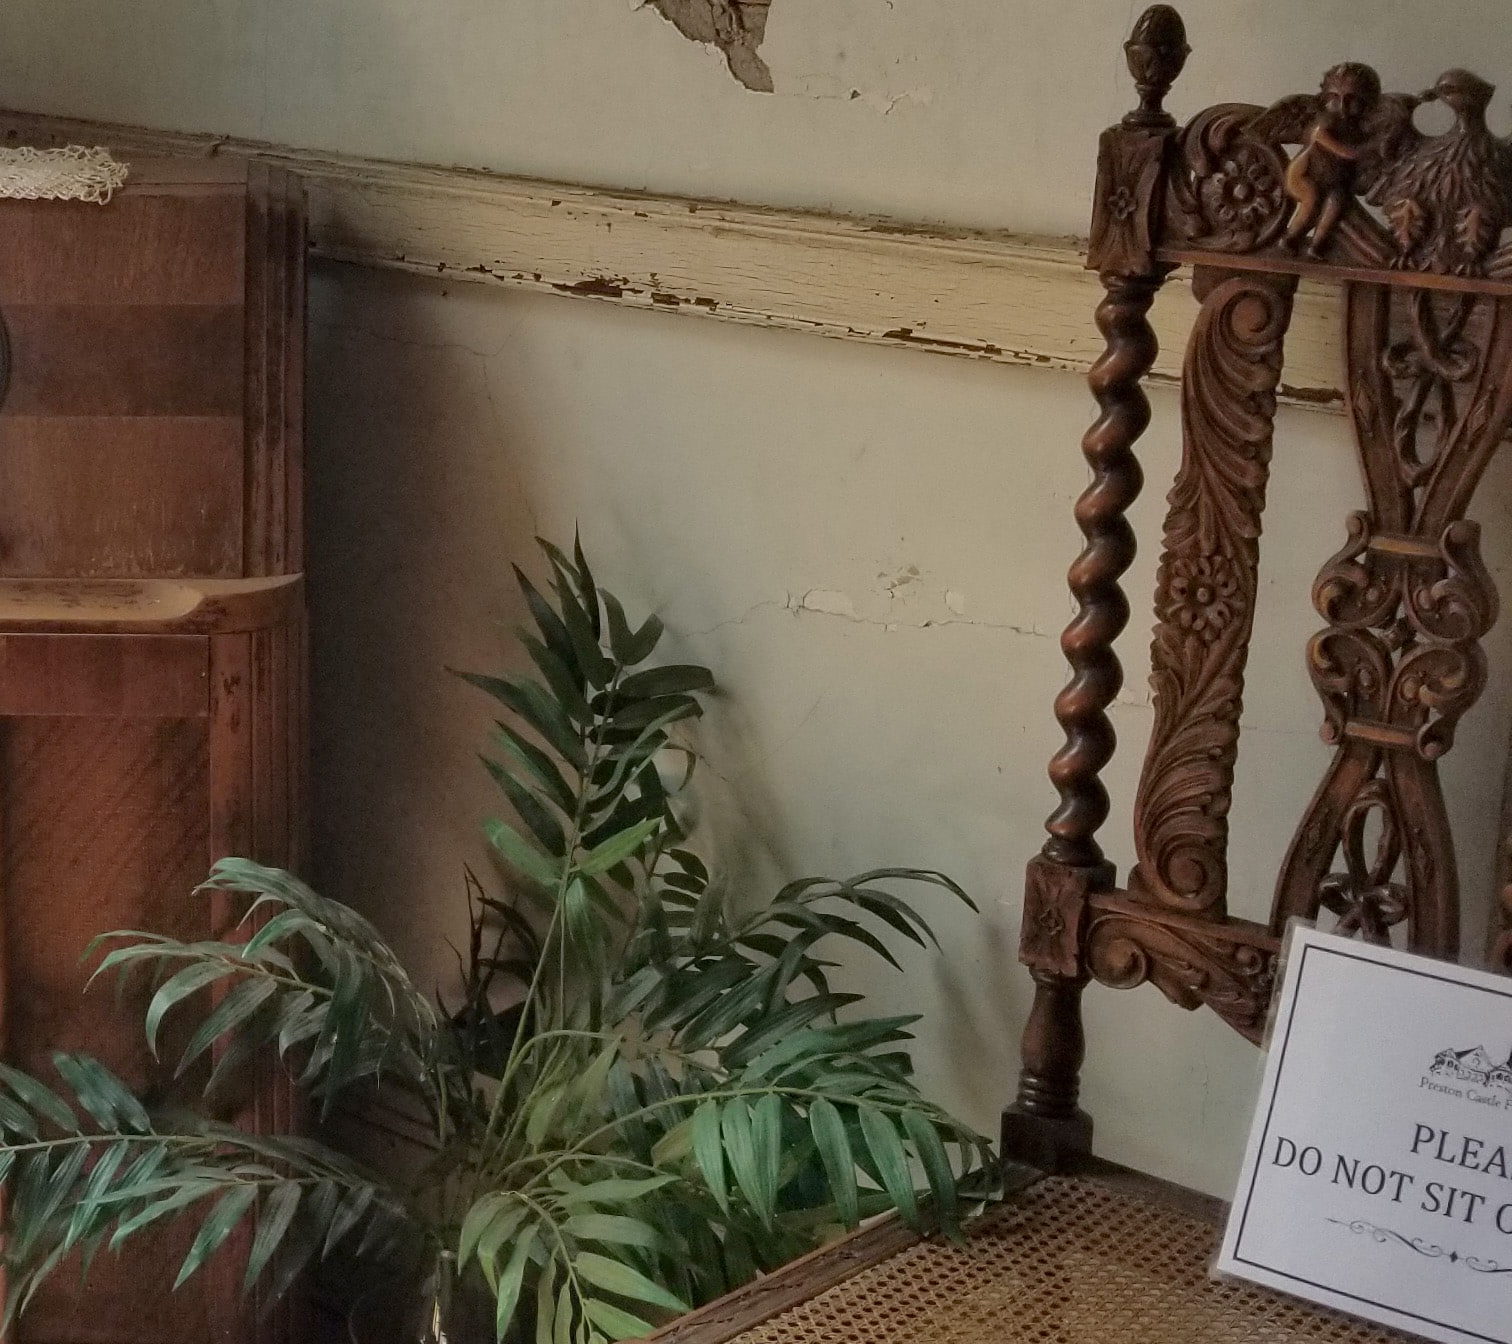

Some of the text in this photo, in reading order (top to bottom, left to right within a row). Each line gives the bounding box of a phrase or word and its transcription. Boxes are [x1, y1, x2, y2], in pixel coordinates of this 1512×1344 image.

[1419, 1076, 1462, 1098] Preston
[1272, 1136, 1322, 1175] DO
[1331, 1155, 1414, 1203] NOT
[1420, 1182, 1486, 1223] SIT
[1410, 1123, 1512, 1180] PLEA
